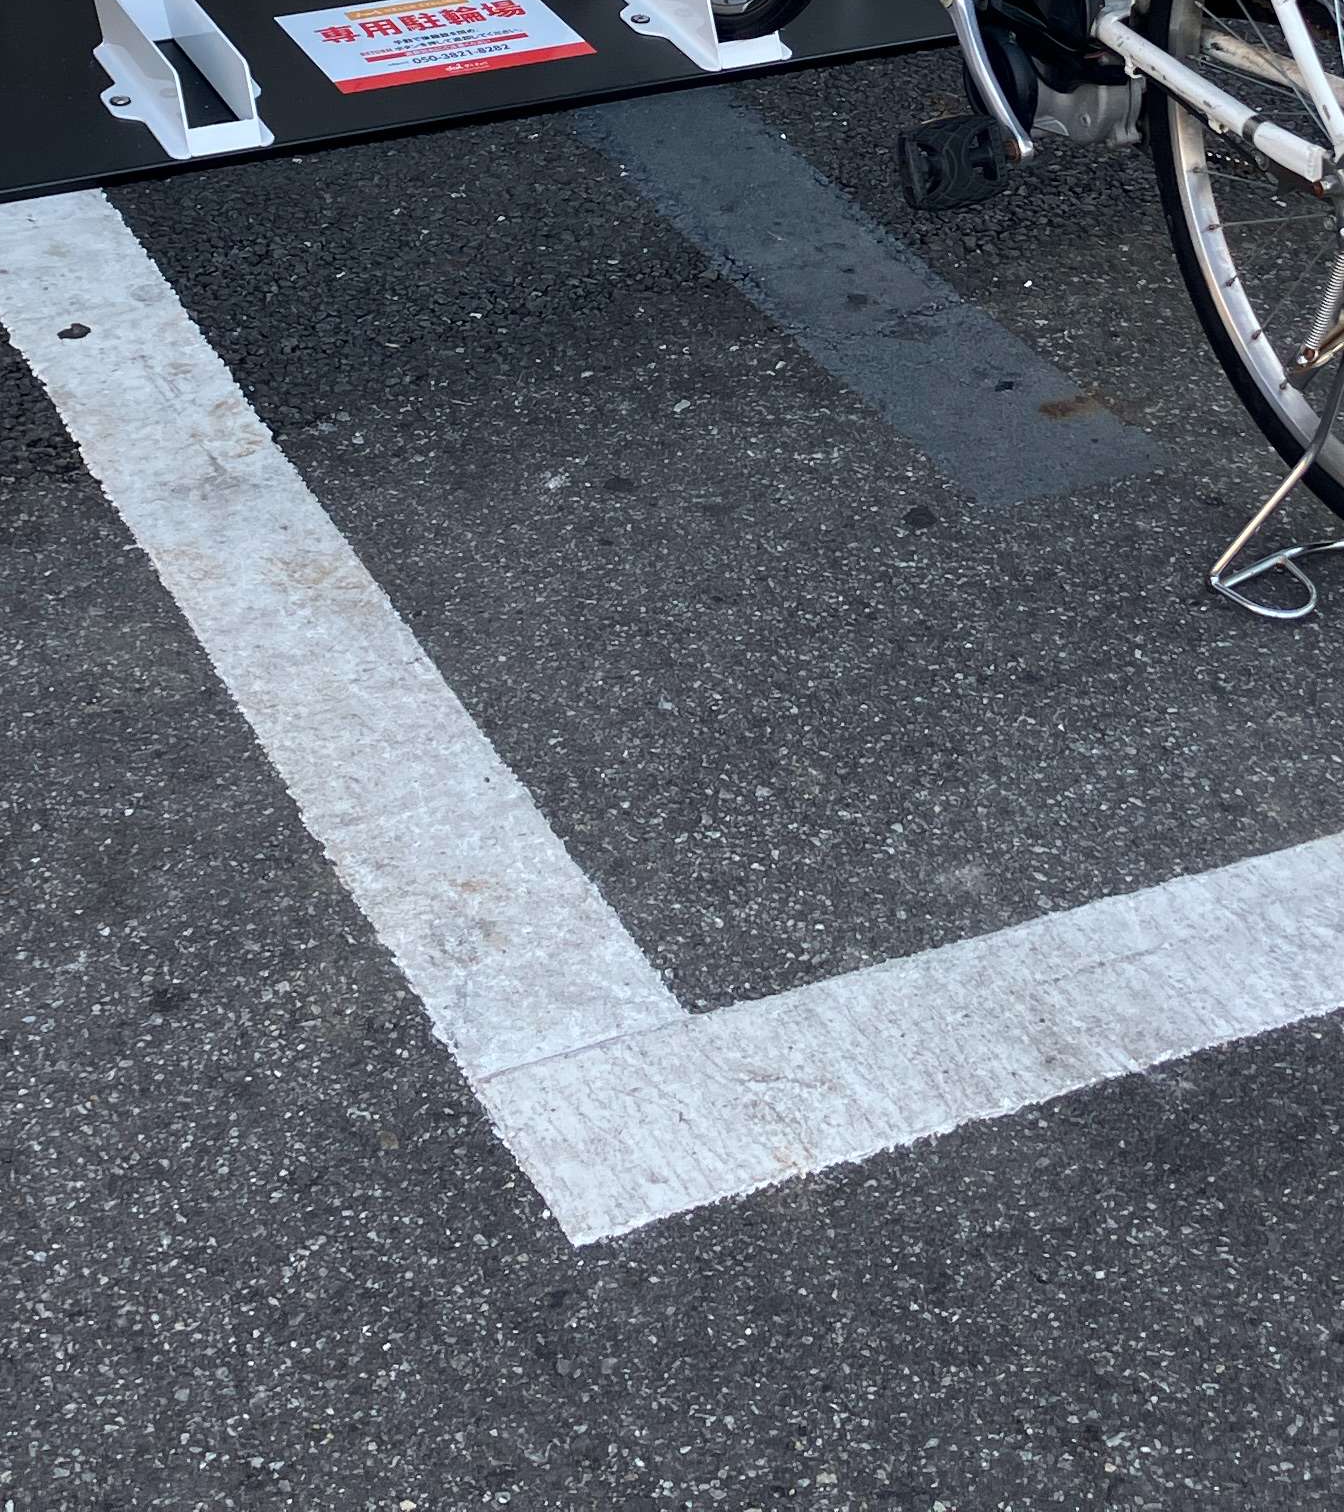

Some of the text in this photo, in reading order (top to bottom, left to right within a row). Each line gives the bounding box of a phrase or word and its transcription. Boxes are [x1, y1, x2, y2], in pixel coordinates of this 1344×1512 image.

[313, 0, 527, 44] 専用駐輪場
